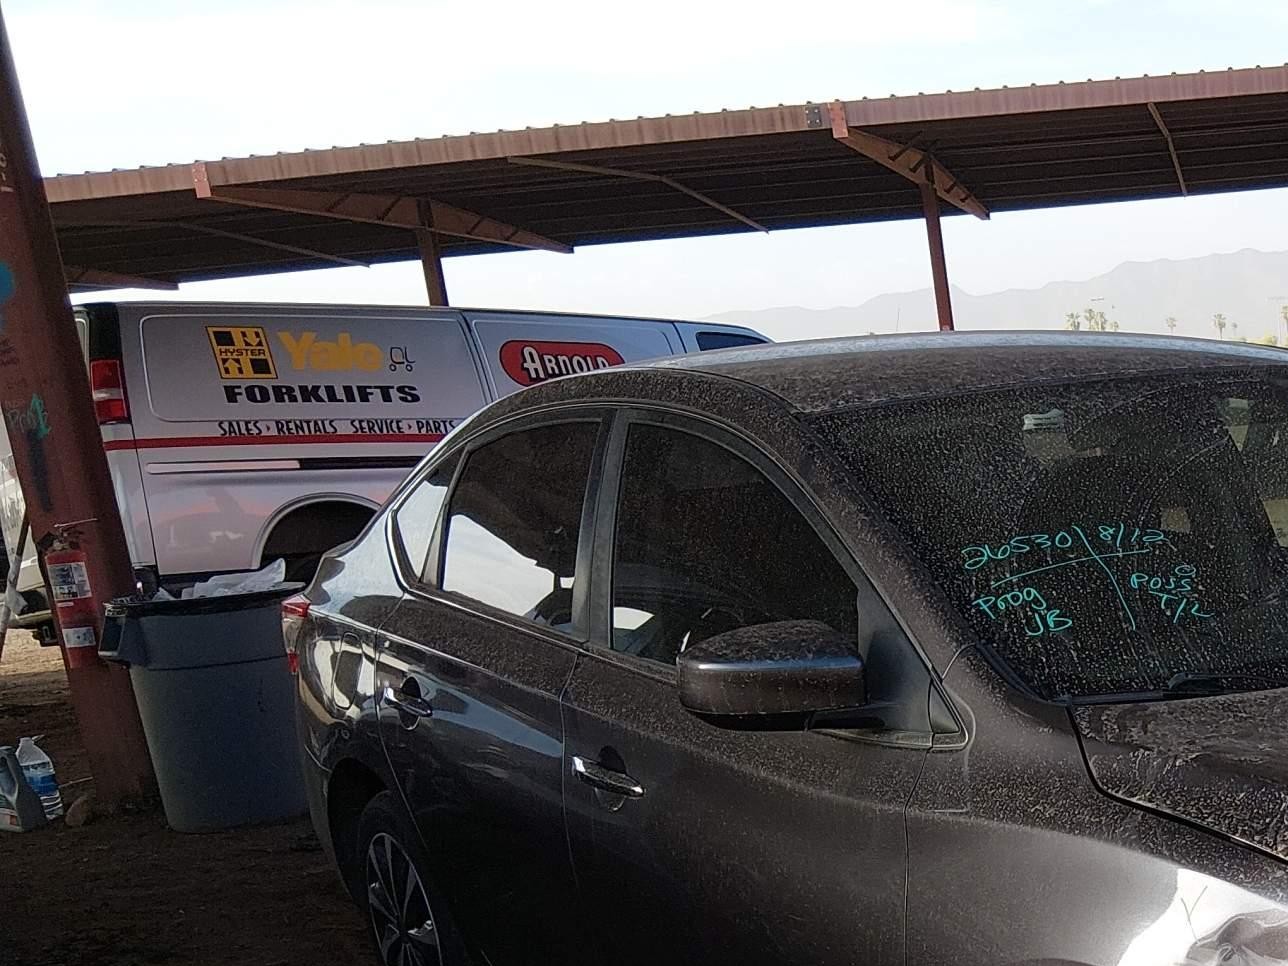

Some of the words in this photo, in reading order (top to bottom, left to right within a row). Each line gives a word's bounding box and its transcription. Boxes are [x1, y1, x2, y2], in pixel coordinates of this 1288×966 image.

[218, 347, 266, 358] HYSTER
[276, 330, 384, 373] Yale
[222, 384, 422, 405] FORKLIFTS
[217, 420, 264, 437] SALES
[275, 419, 339, 436] RENTALS
[349, 418, 405, 435] SERVICE
[416, 418, 458, 435] PARTS
[961, 530, 1073, 570] 26530
[1025, 609, 1073, 636] JB
